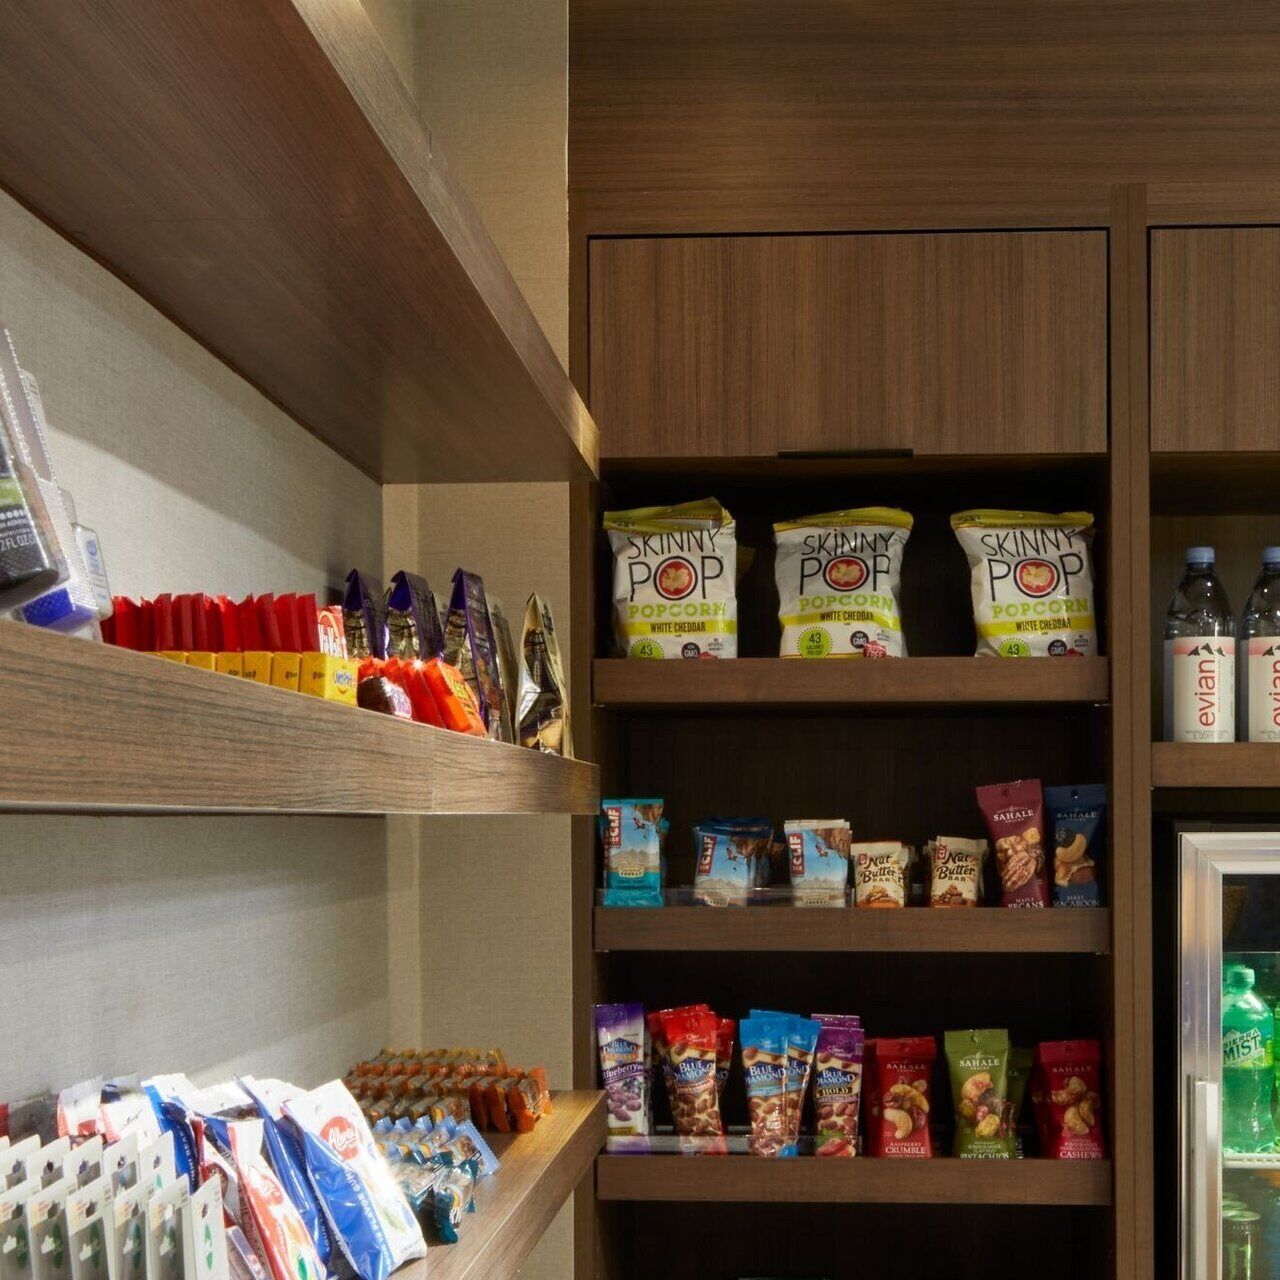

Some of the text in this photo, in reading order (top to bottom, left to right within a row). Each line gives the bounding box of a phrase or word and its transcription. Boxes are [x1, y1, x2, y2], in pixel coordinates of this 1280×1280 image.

[626, 529, 722, 560] SKINNY
[802, 528, 896, 557] SKINNY
[980, 527, 1076, 558] SKINNY
[627, 555, 725, 603] POP
[799, 554, 891, 596] POP
[987, 552, 1084, 602] POP
[798, 594, 895, 612] POPCORN
[991, 598, 1090, 619] POPCORN
[627, 602, 728, 620] POPCORN
[820, 610, 875, 621] WHITE CHEDDAR
[650, 620, 706, 634] WHITE CHEDDAR
[1015, 618, 1072, 633] WHITE CHEDDAR
[808, 632, 822, 645] 43
[639, 644, 654, 657] 43
[1007, 643, 1020, 656] 43
[1194, 659, 1216, 727] evian
[993, 808, 1036, 823] SAHALE
[1055, 810, 1098, 819] SAHALE
[864, 854, 892, 870] Nut
[942, 851, 970, 865] Nut
[860, 866, 897, 882] Butter
[935, 864, 976, 881] Butter
[1222, 1036, 1260, 1067] MIST
[750, 1064, 773, 1076] BLUE
[886, 1063, 927, 1071] SAHALE
[959, 1058, 1000, 1067] SAHALE
[1051, 1066, 1093, 1074] SAHALE
[822, 1069, 843, 1079] BLUE
[885, 1146, 926, 1154] CRUMBLE
[1059, 1151, 1102, 1160] CASHEWS
